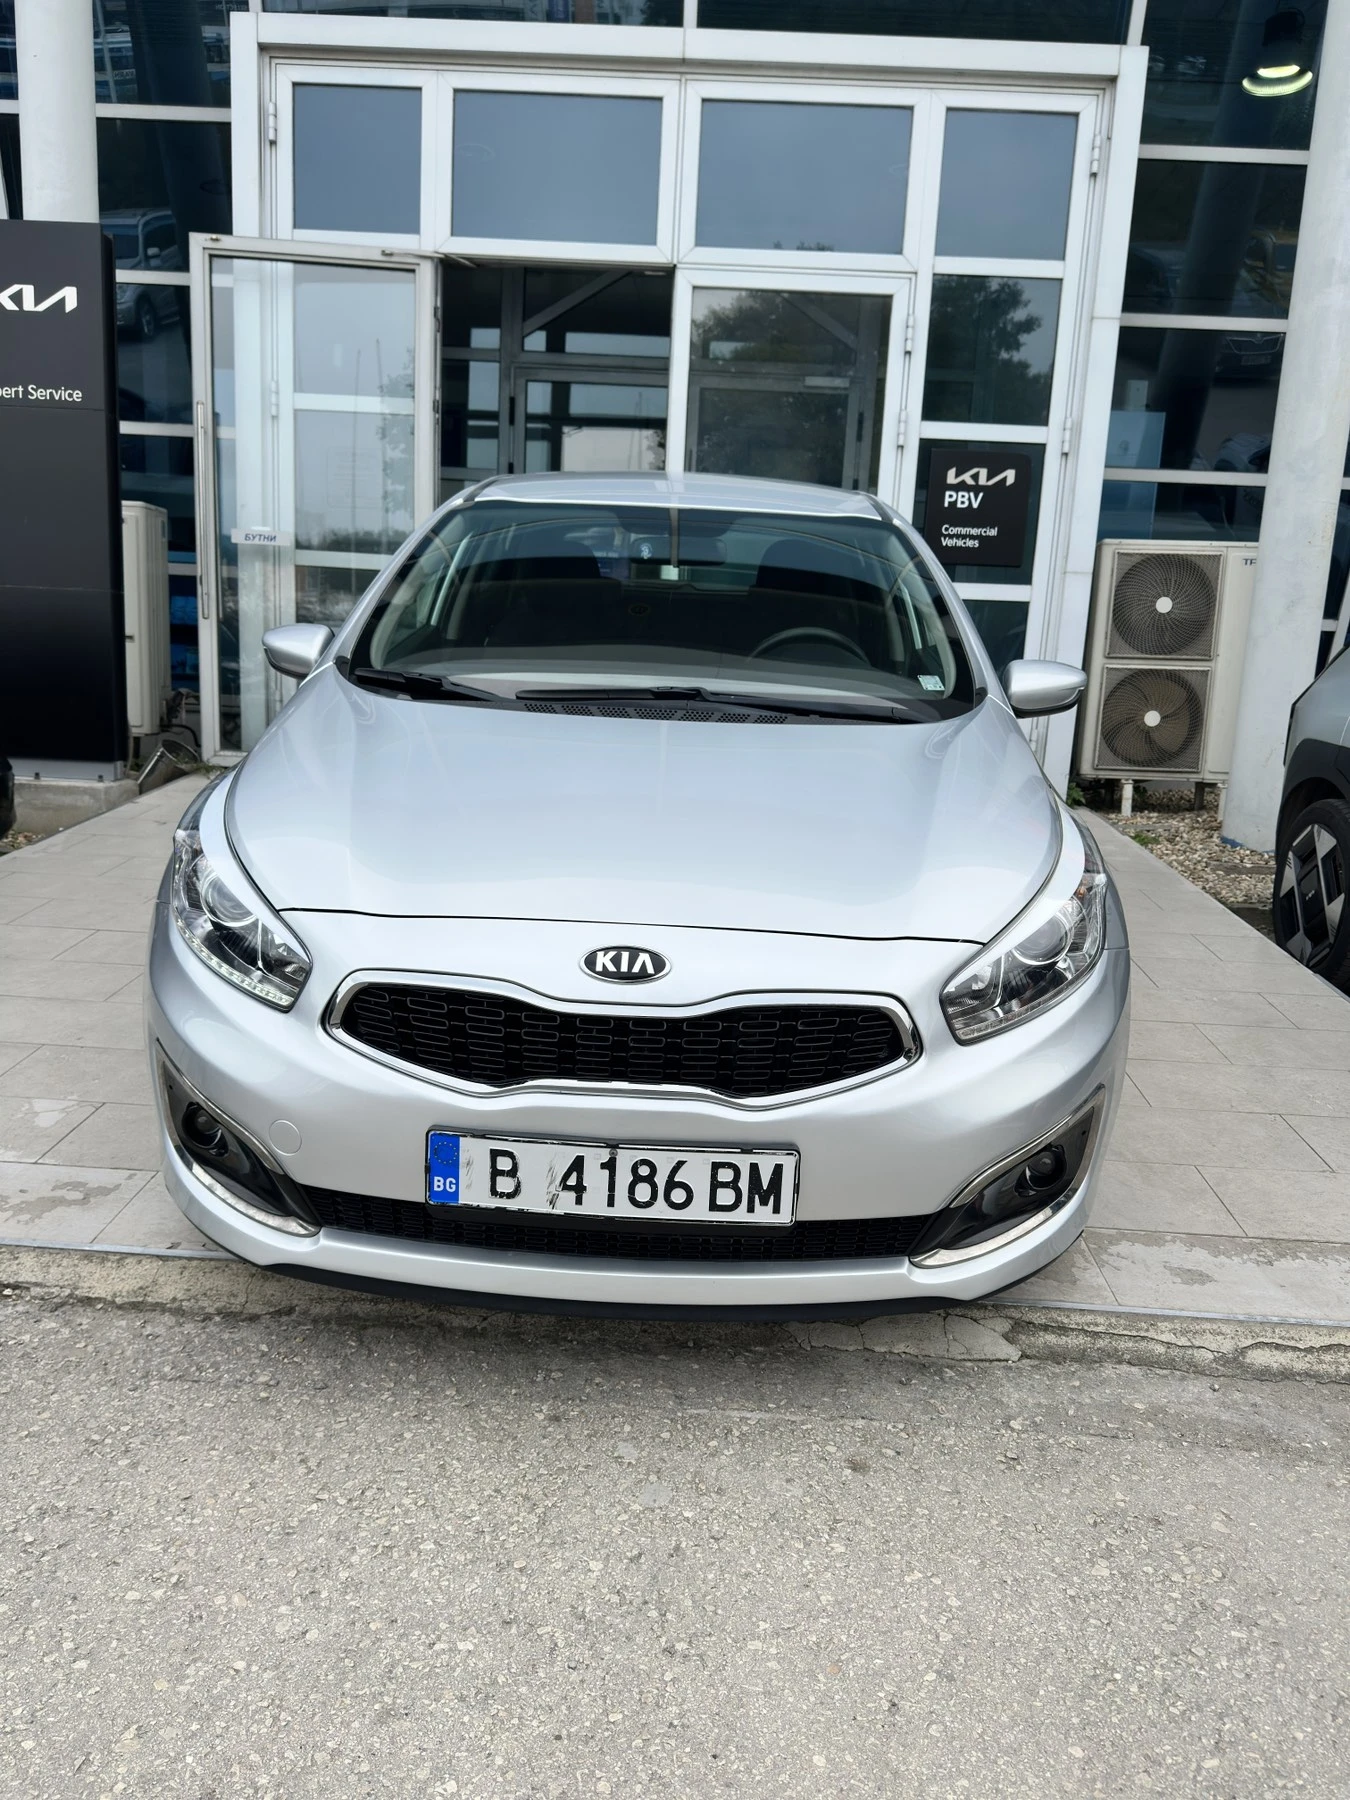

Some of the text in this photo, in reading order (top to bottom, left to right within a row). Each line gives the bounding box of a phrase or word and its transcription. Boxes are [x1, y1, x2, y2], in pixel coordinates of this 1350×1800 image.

[27, 384, 83, 402] Service
[946, 466, 1016, 487] KIA
[943, 490, 984, 509] PBV
[244, 533, 277, 542] БУТНИ
[941, 524, 998, 537] Commercial
[940, 536, 980, 548] Vehicles
[595, 950, 655, 974] KIA
[433, 1175, 457, 1193] BG
[556, 1153, 694, 1212] 4186
[708, 1160, 784, 1215] BM
